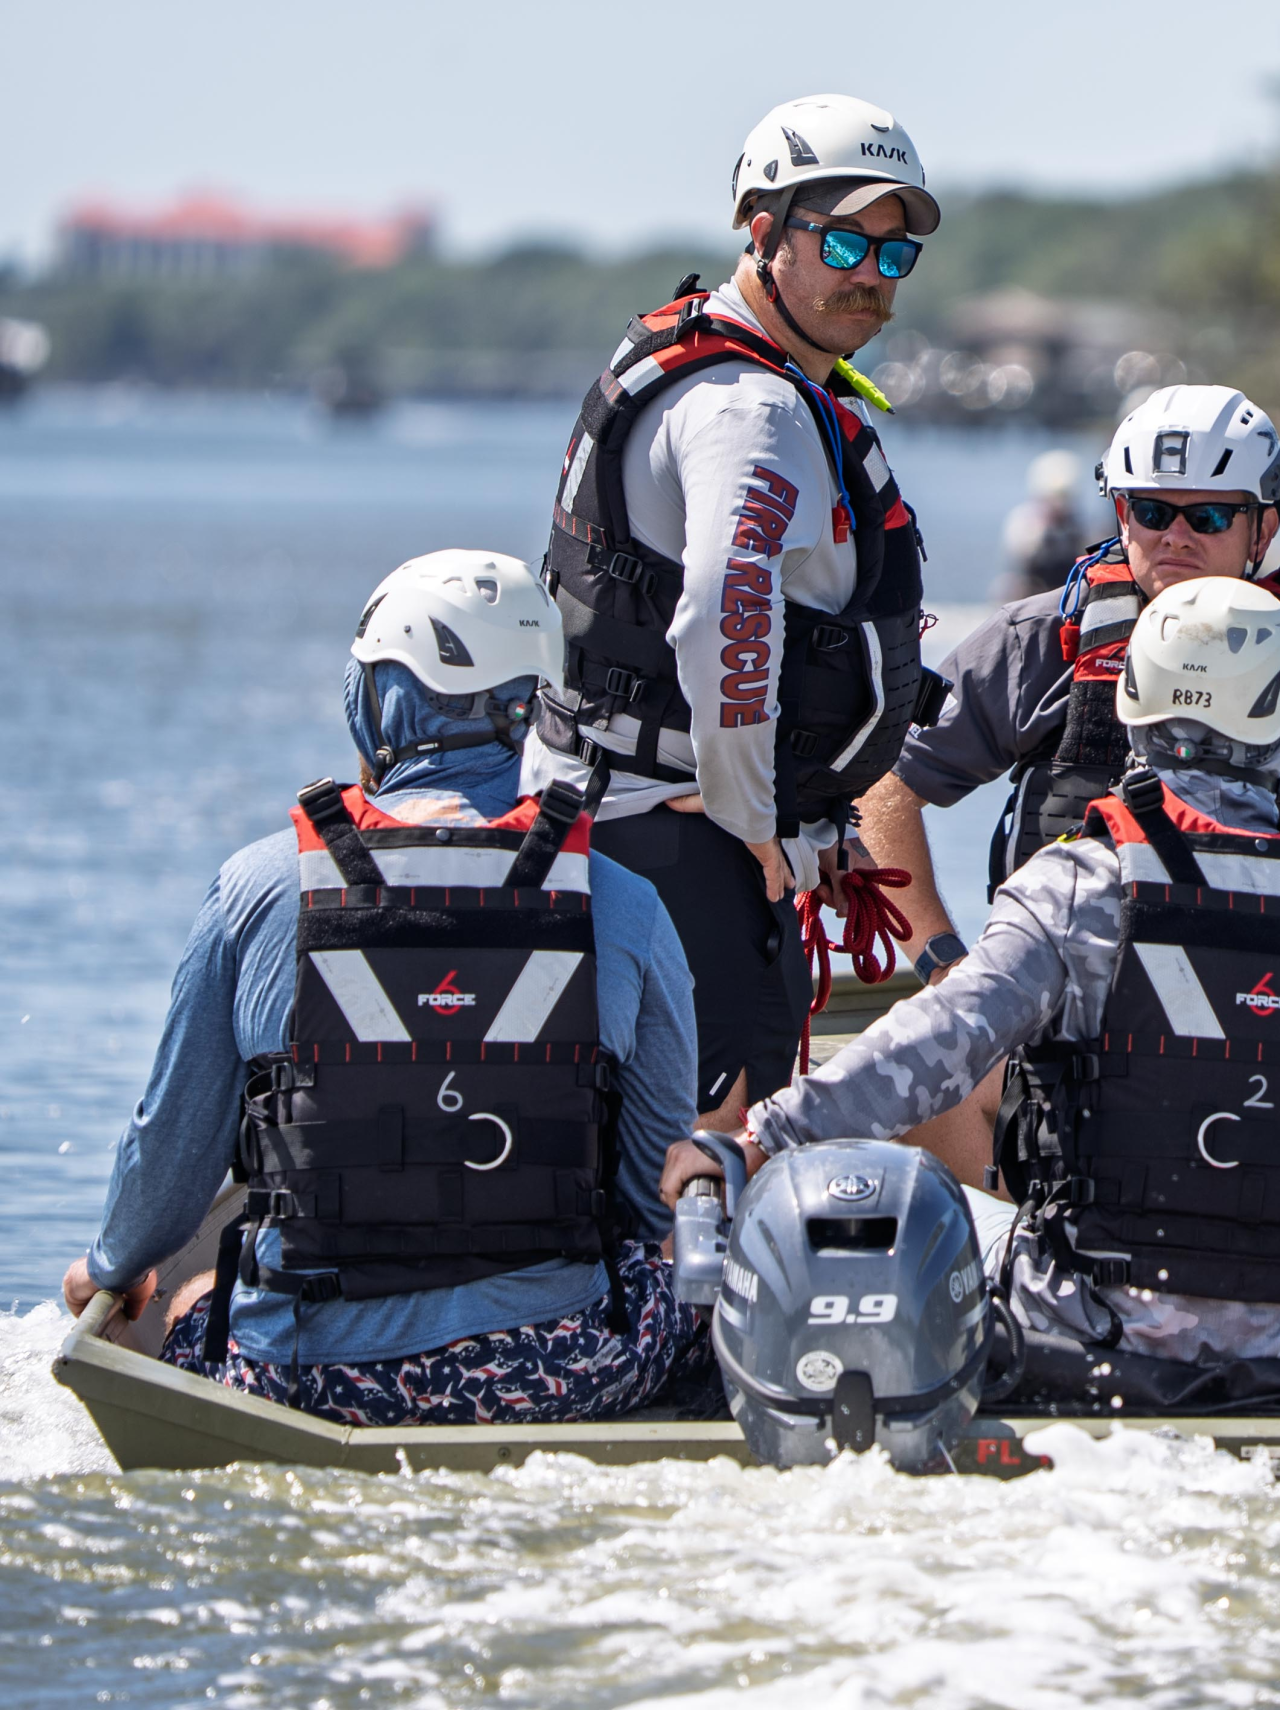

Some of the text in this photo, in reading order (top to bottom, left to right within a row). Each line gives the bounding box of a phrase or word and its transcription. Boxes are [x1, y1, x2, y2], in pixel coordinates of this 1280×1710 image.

[860, 142, 909, 166] KASK
[719, 464, 800, 728] FIRE RESCUE
[1095, 658, 1126, 669] FORC
[1182, 662, 1208, 673] KASK
[1171, 688, 1213, 709] RB73
[417, 994, 477, 1007] FORCE
[436, 1071, 464, 1113] 6
[1243, 1074, 1275, 1109] 2
[807, 1293, 899, 1325] 9.9
[977, 1439, 1021, 1465] FL
